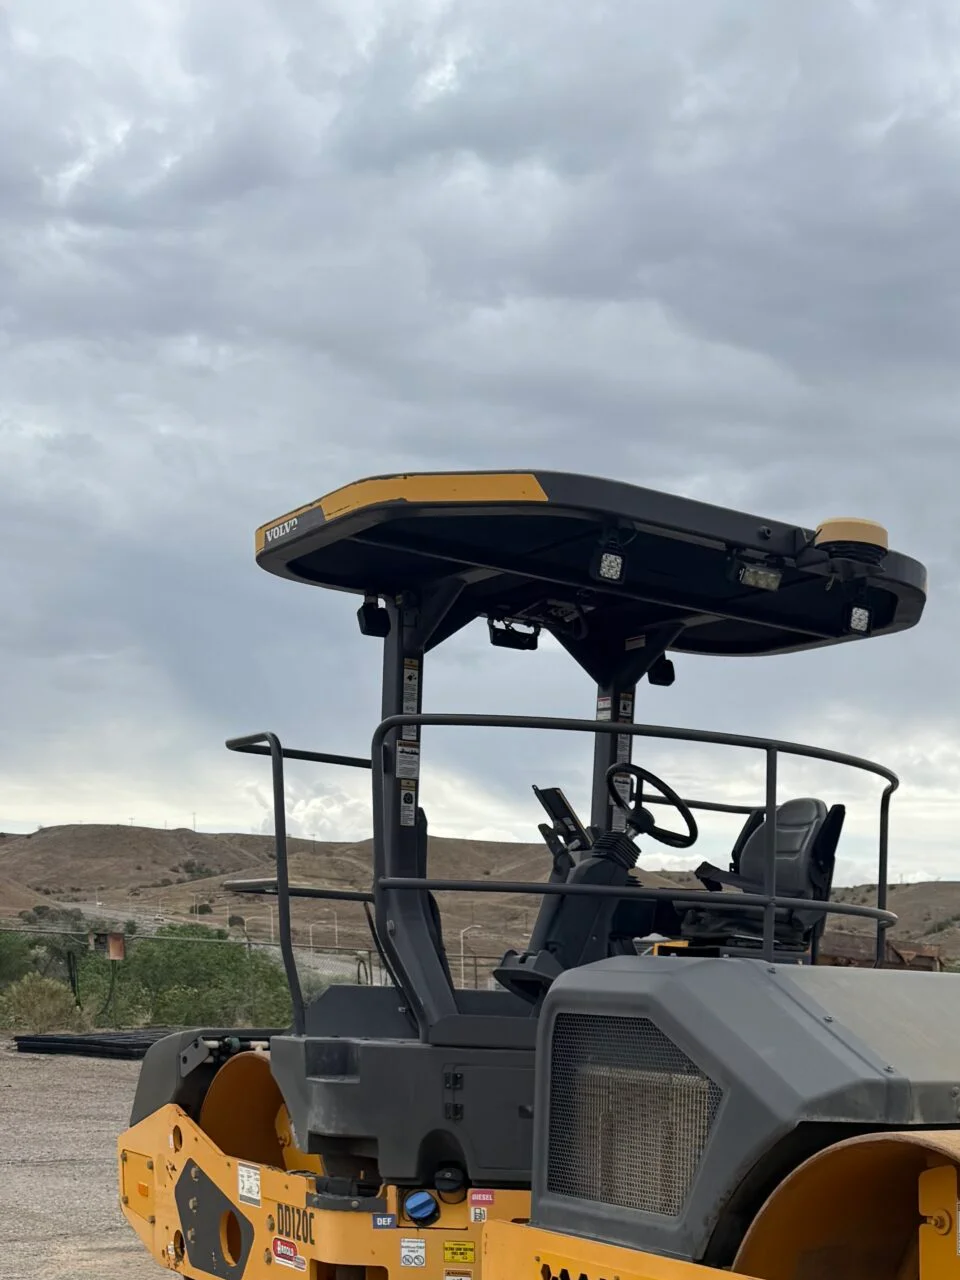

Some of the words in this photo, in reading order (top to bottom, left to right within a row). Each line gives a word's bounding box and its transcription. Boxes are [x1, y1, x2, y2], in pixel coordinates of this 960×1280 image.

[471, 1193, 493, 1201] DIESEL
[277, 1203, 315, 1246] DD120C
[376, 1217, 392, 1226] DEF
